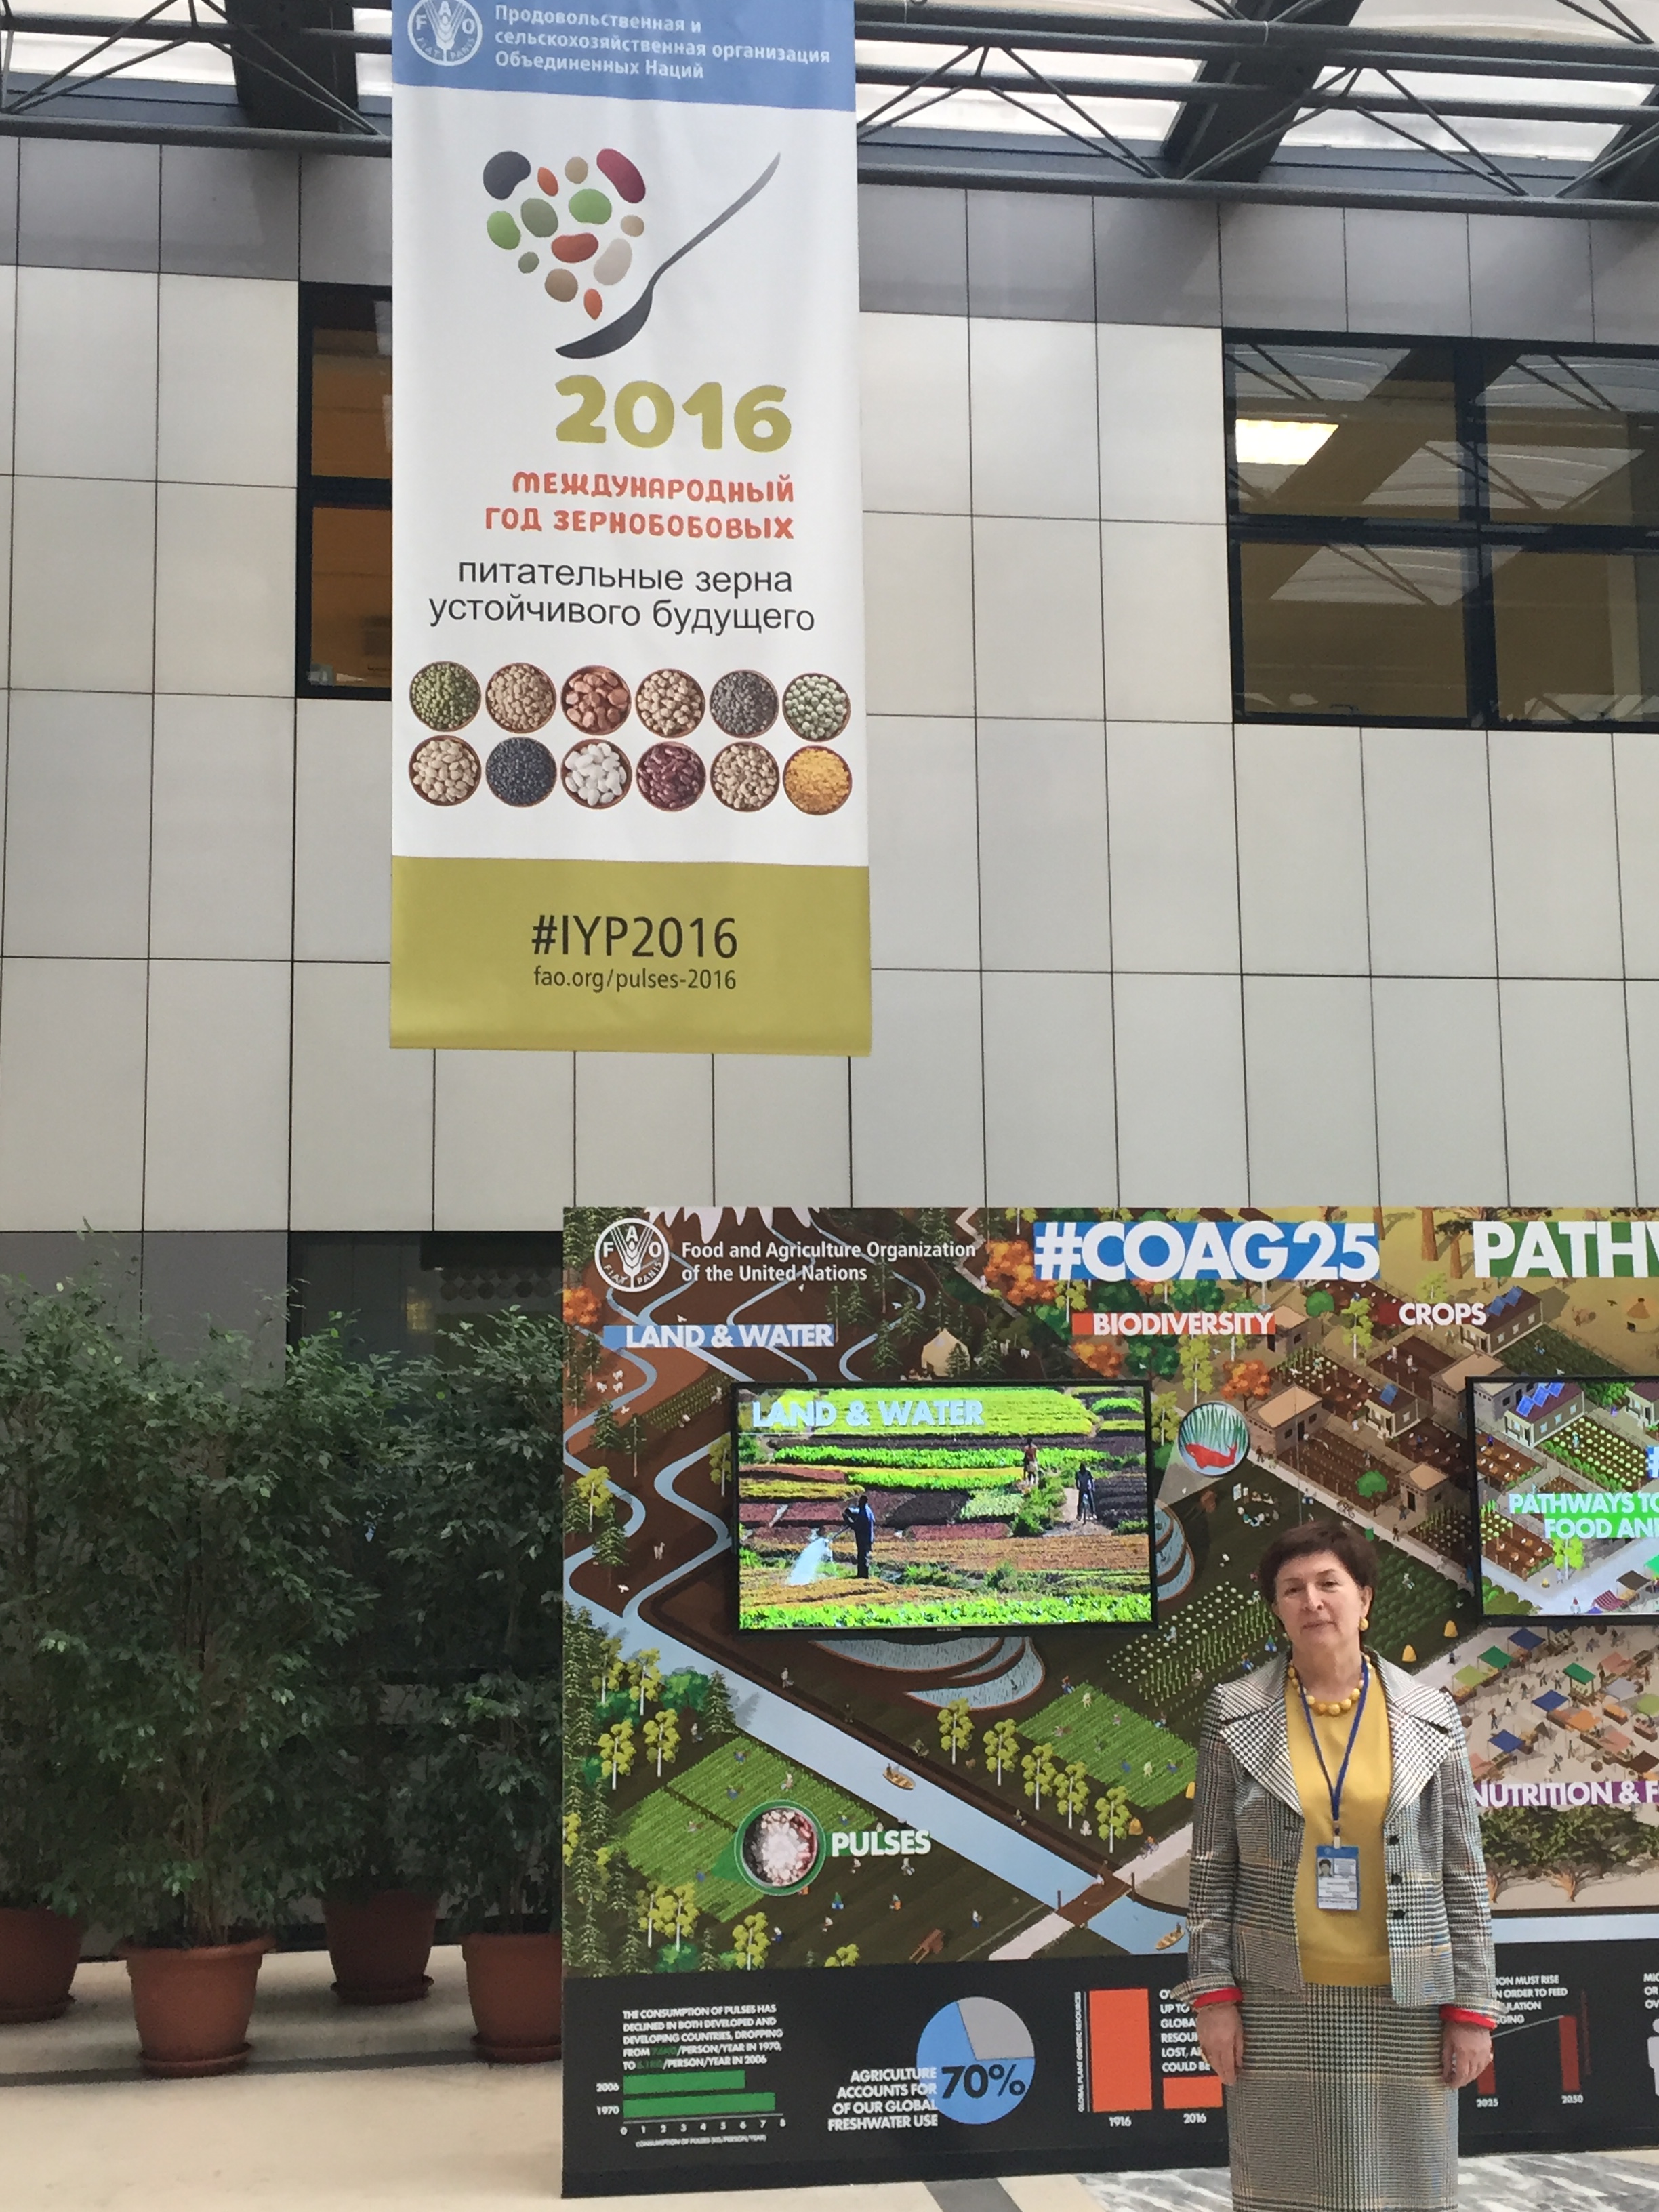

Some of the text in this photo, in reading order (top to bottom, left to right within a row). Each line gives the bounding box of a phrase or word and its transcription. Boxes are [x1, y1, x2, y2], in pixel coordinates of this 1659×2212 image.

[495, 5, 701, 33] Продовольственная и
[495, 31, 830, 64] сельскохозяйственная организация
[495, 50, 704, 79] Объединенных Наций
[555, 374, 792, 453] 2016
[512, 472, 794, 502] МЕЖДУНАРОДНЫЙ
[485, 508, 794, 539] ГОД ЗЕРНОБОБОВЫХ
[458, 562, 792, 598] питательные зерна
[429, 594, 815, 636] устойчивого будущего
[532, 915, 737, 958] #IYP2016
[534, 966, 737, 993] fao.org/pulses-2016
[603, 1226, 662, 1258] FAO
[682, 1241, 976, 1263] Food and Agriculture Organization
[1035, 1221, 1378, 1282] #COAG25
[682, 1265, 867, 1282] of the United Nations
[1093, 1311, 1274, 1336] BIODIVERSITY
[1399, 1303, 1487, 1326] CROPS
[626, 1324, 834, 1349] LAND & WATER
[752, 1399, 985, 1427] LAND & WATER
[1509, 1492, 1635, 1514] PATHWAYS
[1545, 1517, 1612, 1539] FOOD
[1618, 1781, 1641, 1806] &
[832, 1830, 931, 1857] PULSES
[1515, 1975, 1540, 1986] MUST
[1541, 1975, 1559, 1984] RISE
[1504, 1988, 1534, 1999] ORDER
[1534, 1988, 1547, 1998] TO
[1548, 1987, 1568, 1997] FEED
[623, 2004, 777, 2020] THE CONSUMPTION OF PULSES HAS
[1160, 2004, 1174, 2014] UP
[623, 2017, 777, 2032] DECLINED IN BOTH DEVELOPED AND
[1160, 2018, 1197, 2028] GLOBA
[623, 2033, 680, 2045] DEVELOPING
[735, 2028, 783, 2039] DROPPING
[623, 2047, 651, 2057] FROM
[746, 2043, 757, 2052] IN
[1161, 2047, 1189, 2058] LOST,
[623, 2061, 636, 2070] TO
[732, 2055, 743, 2065] IN
[744, 2054, 767, 2064] 2006
[1162, 2062, 1197, 2072] COULD
[850, 2067, 937, 2083] AGRICULTURE
[941, 2064, 1026, 2100] 70%
[596, 2083, 619, 2093] 2006
[836, 2083, 937, 2100] ACCOUNTS FOR
[596, 2106, 619, 2116] 1970
[832, 2099, 938, 2116] OF OUR GLOBAL
[1183, 2113, 1207, 2124] 2016
[620, 2118, 786, 2135] 0 1 2 3 4 5 6 7 8
[827, 2114, 939, 2132] FRESHWATER USE
[1109, 2116, 1132, 2127] 1916
